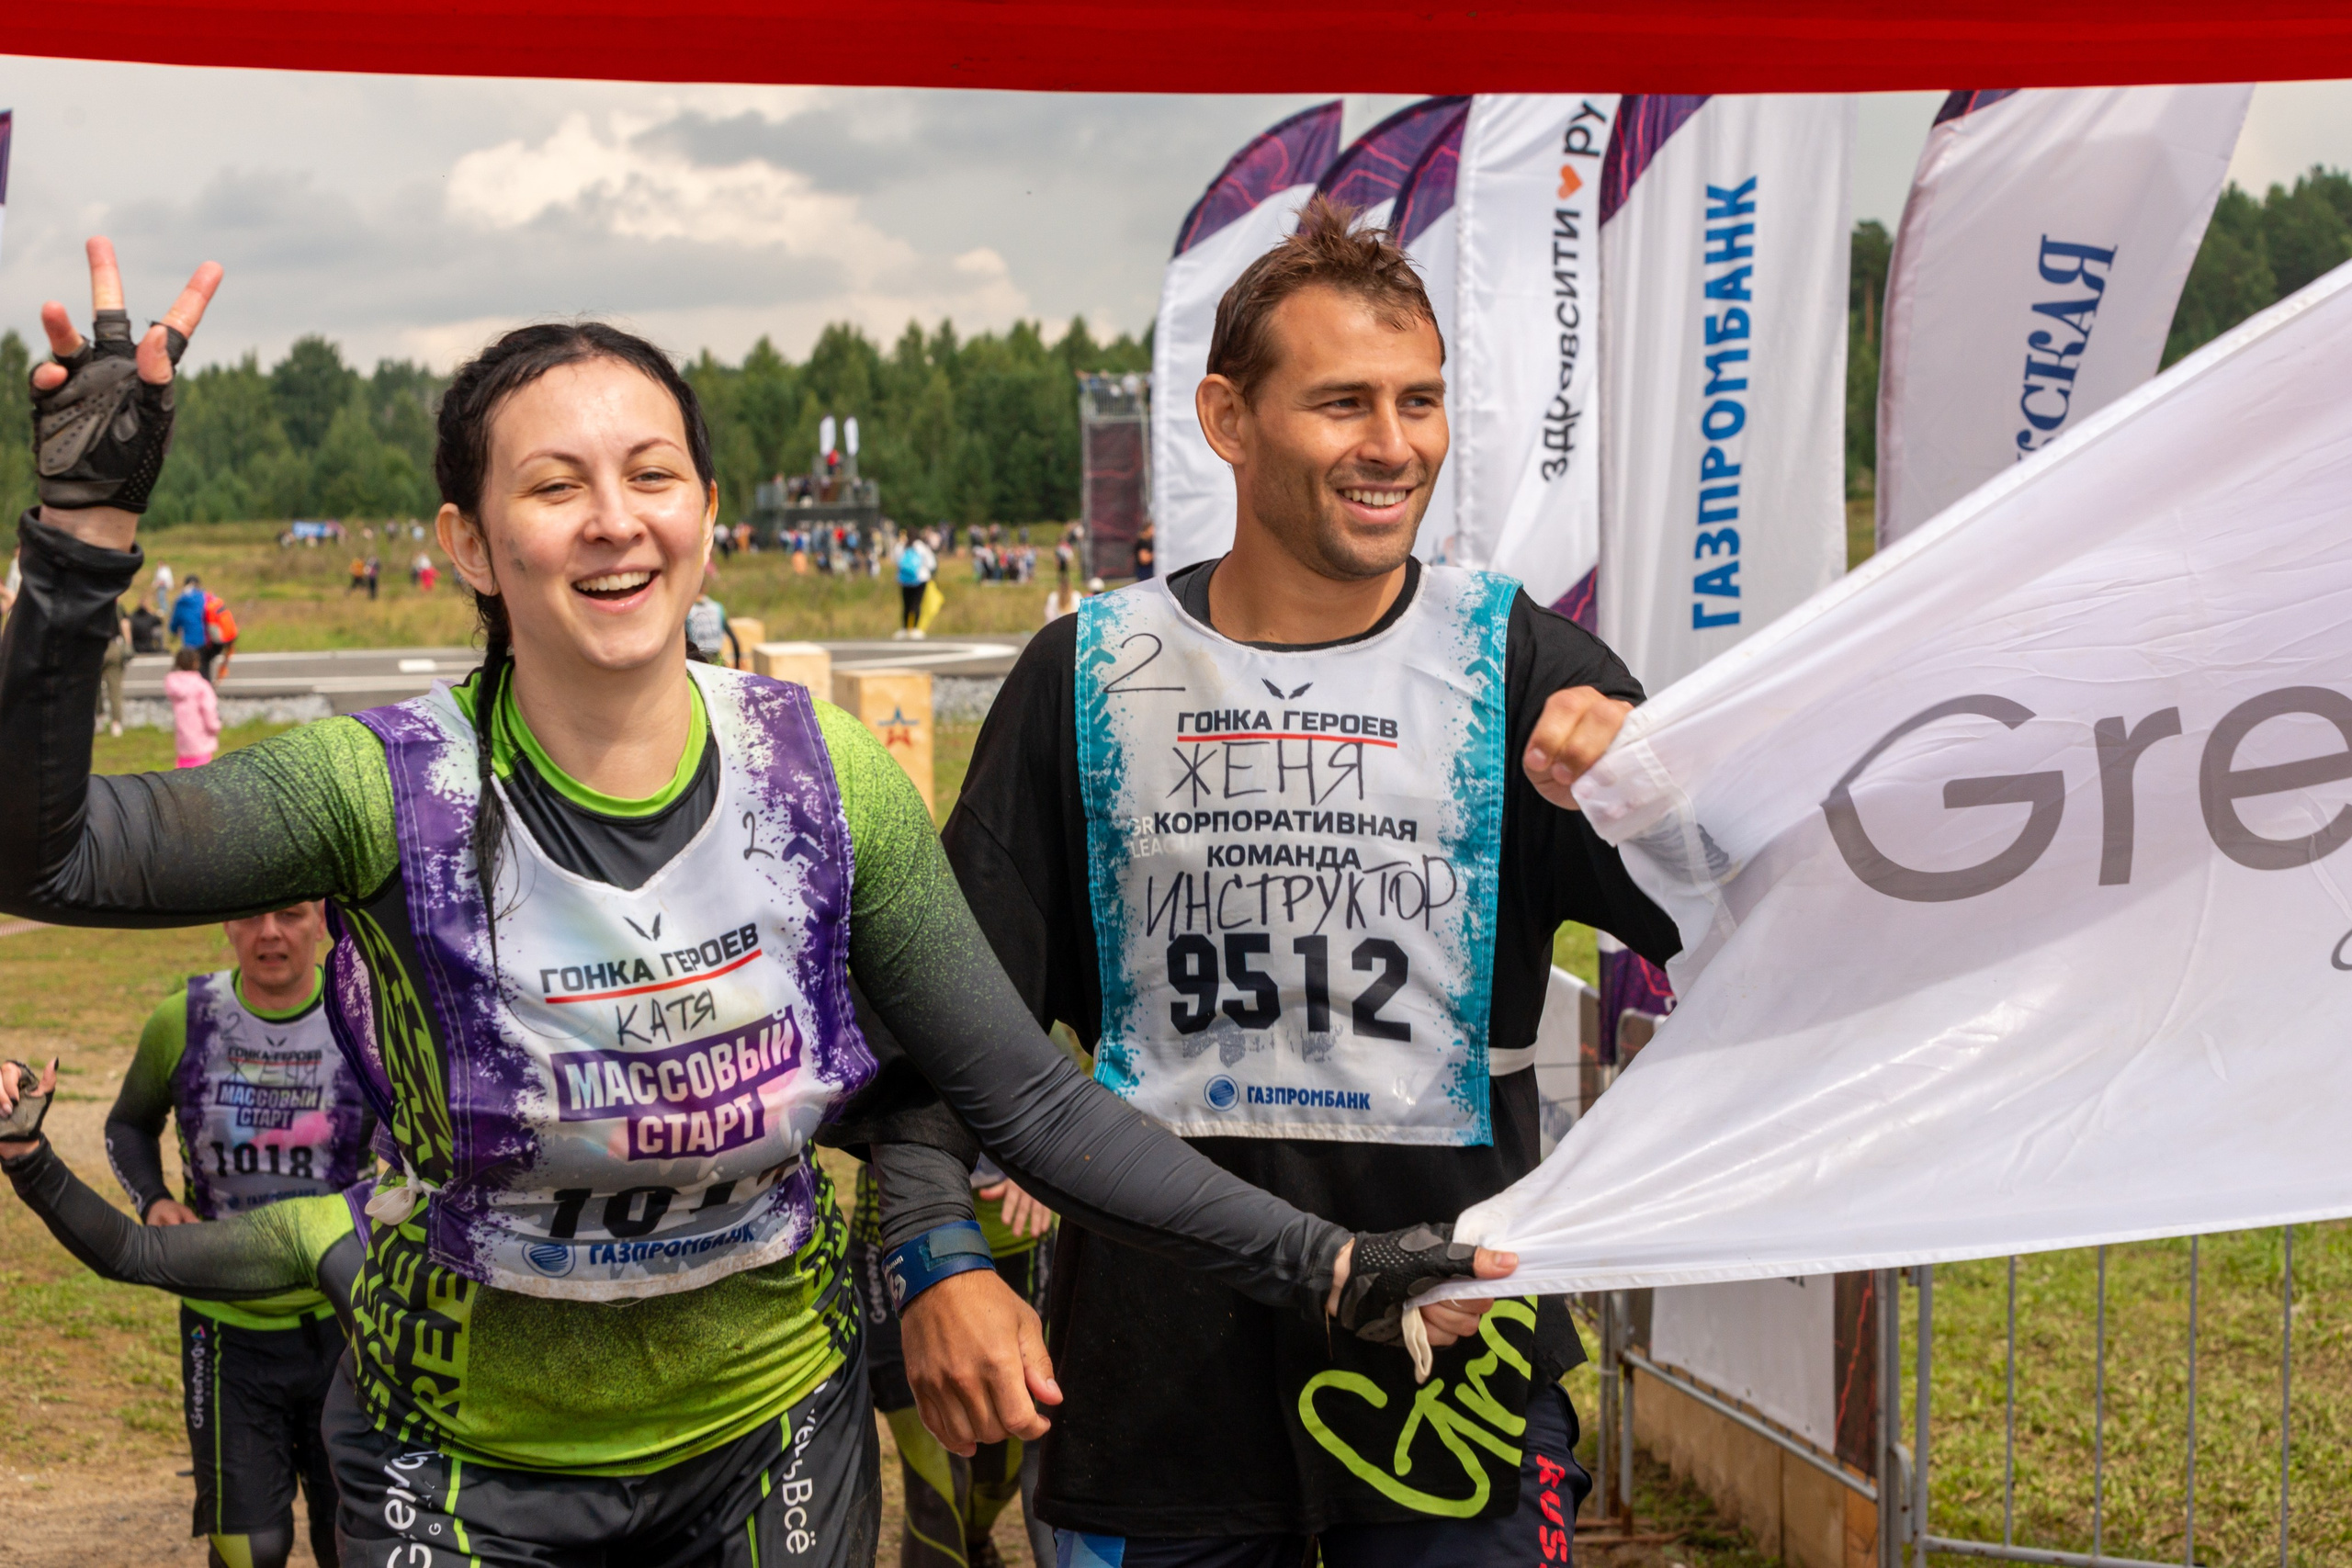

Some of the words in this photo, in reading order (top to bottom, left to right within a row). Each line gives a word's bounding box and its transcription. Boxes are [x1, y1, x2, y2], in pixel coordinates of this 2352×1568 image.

[1692, 175, 1758, 631] ГАЗПРОМБАНК
[1103, 633, 1185, 693] 2
[1177, 708, 1272, 734] ГОНКА
[1283, 710, 1398, 738] ГЕРОЕВ
[1166, 738, 1364, 807] ЖЕНЯ
[1820, 686, 2352, 902] Gre
[742, 811, 775, 860] 2
[1154, 810, 1418, 843] КОРПОРАТИВНАЯ
[1207, 843, 1362, 874] КОМАНДА
[1147, 854, 1458, 941] ИНСТРУКТОР
[540, 957, 654, 994] ГОНКА
[662, 921, 760, 976] ГЕРОЕВ
[1167, 932, 1411, 1042] 9512
[616, 987, 717, 1046] КАТЯ
[565, 1007, 796, 1111] МАССОВЫЙ
[219, 1085, 319, 1108] МАССОВЫЙ
[239, 1107, 291, 1129] СТАРТ
[637, 1094, 754, 1156] СТАРТ
[1247, 1085, 1371, 1111] ГАЗПРОМБАНК
[210, 1141, 313, 1179] 1018
[589, 1223, 755, 1266] ГАЗПРОМБАНК
[1535, 1453, 1569, 1568] RUS
